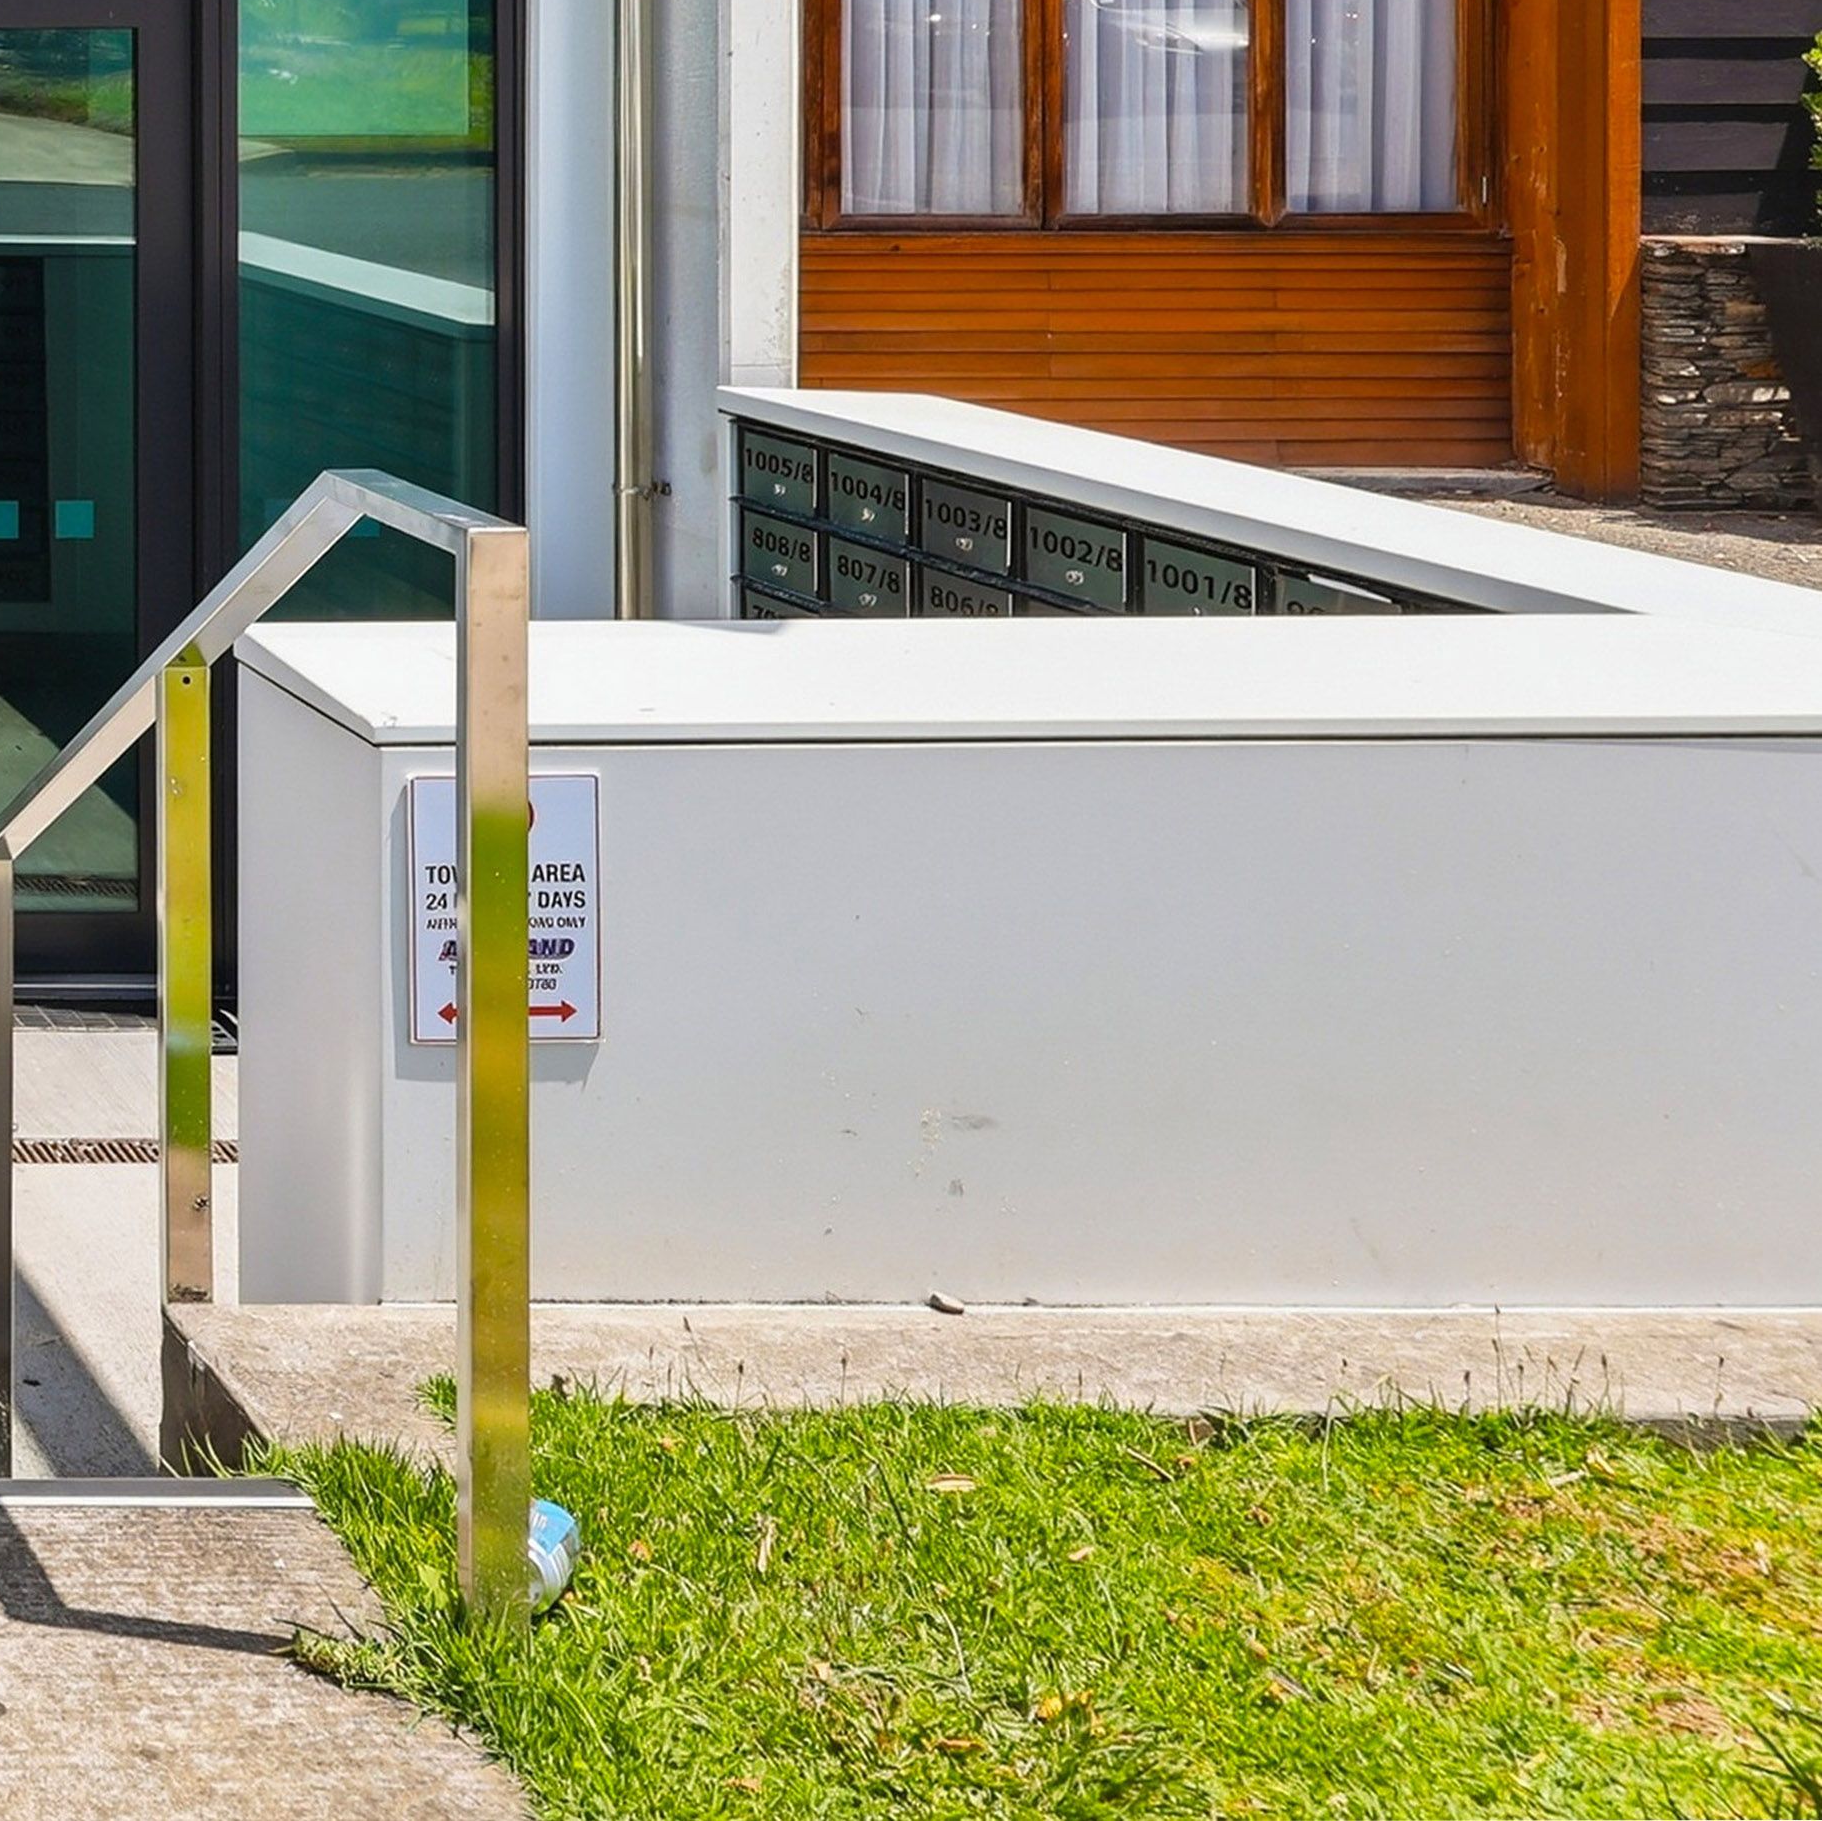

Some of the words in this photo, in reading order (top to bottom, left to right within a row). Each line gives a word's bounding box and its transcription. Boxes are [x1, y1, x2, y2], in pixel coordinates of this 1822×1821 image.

[745, 447, 814, 482] 1005/8
[830, 471, 906, 511] 1004/8
[925, 498, 1007, 540] 1003/8
[752, 527, 810, 563] 808/8
[1029, 526, 1123, 572] 1002/8
[837, 554, 901, 594] 807/8
[1146, 559, 1252, 610] 1001/8
[531, 863, 585, 882] AREA
[426, 893, 447, 910] 24
[538, 890, 586, 908] DAYS
